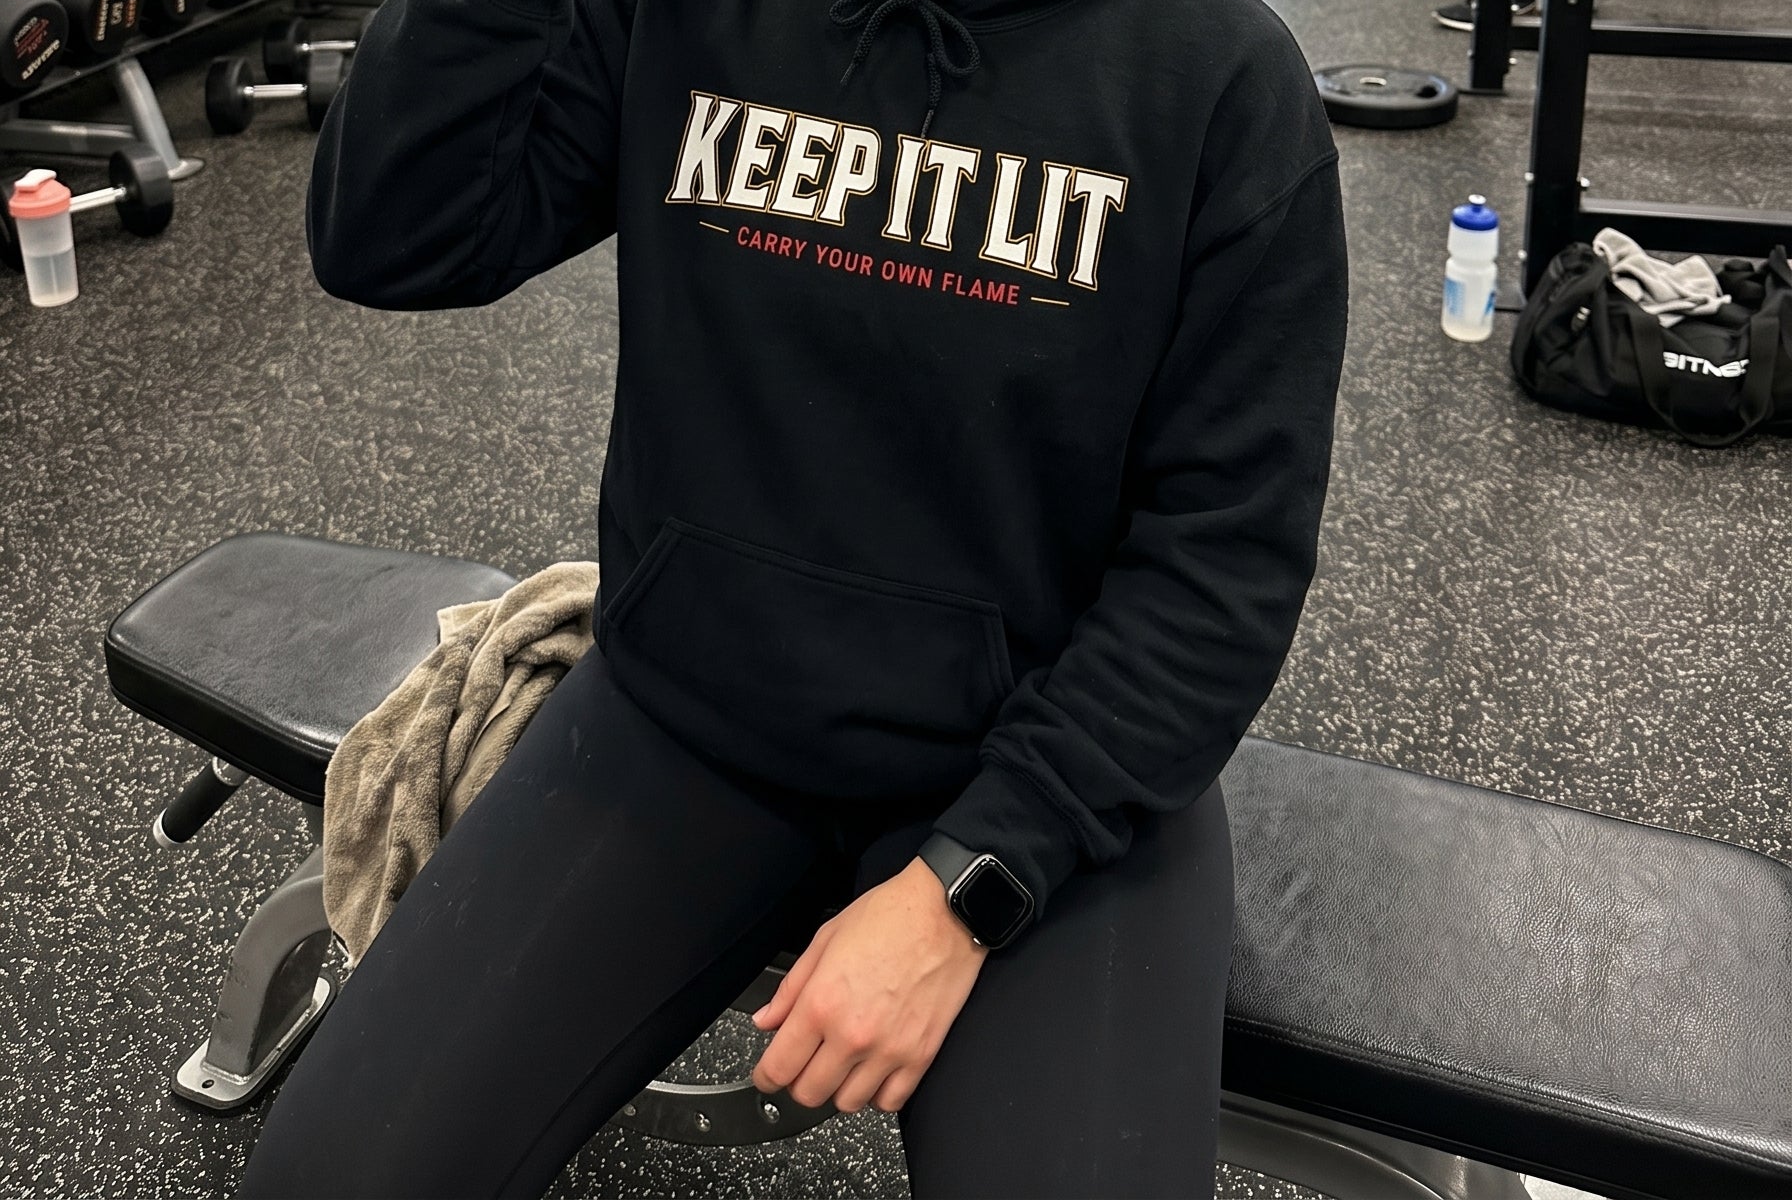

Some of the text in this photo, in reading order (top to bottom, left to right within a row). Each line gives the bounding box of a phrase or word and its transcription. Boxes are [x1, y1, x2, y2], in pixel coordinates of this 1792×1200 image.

[665, 90, 1129, 291] KEEP IT LIT
[737, 226, 1020, 305] CARRY YOUR OWN FLAME
